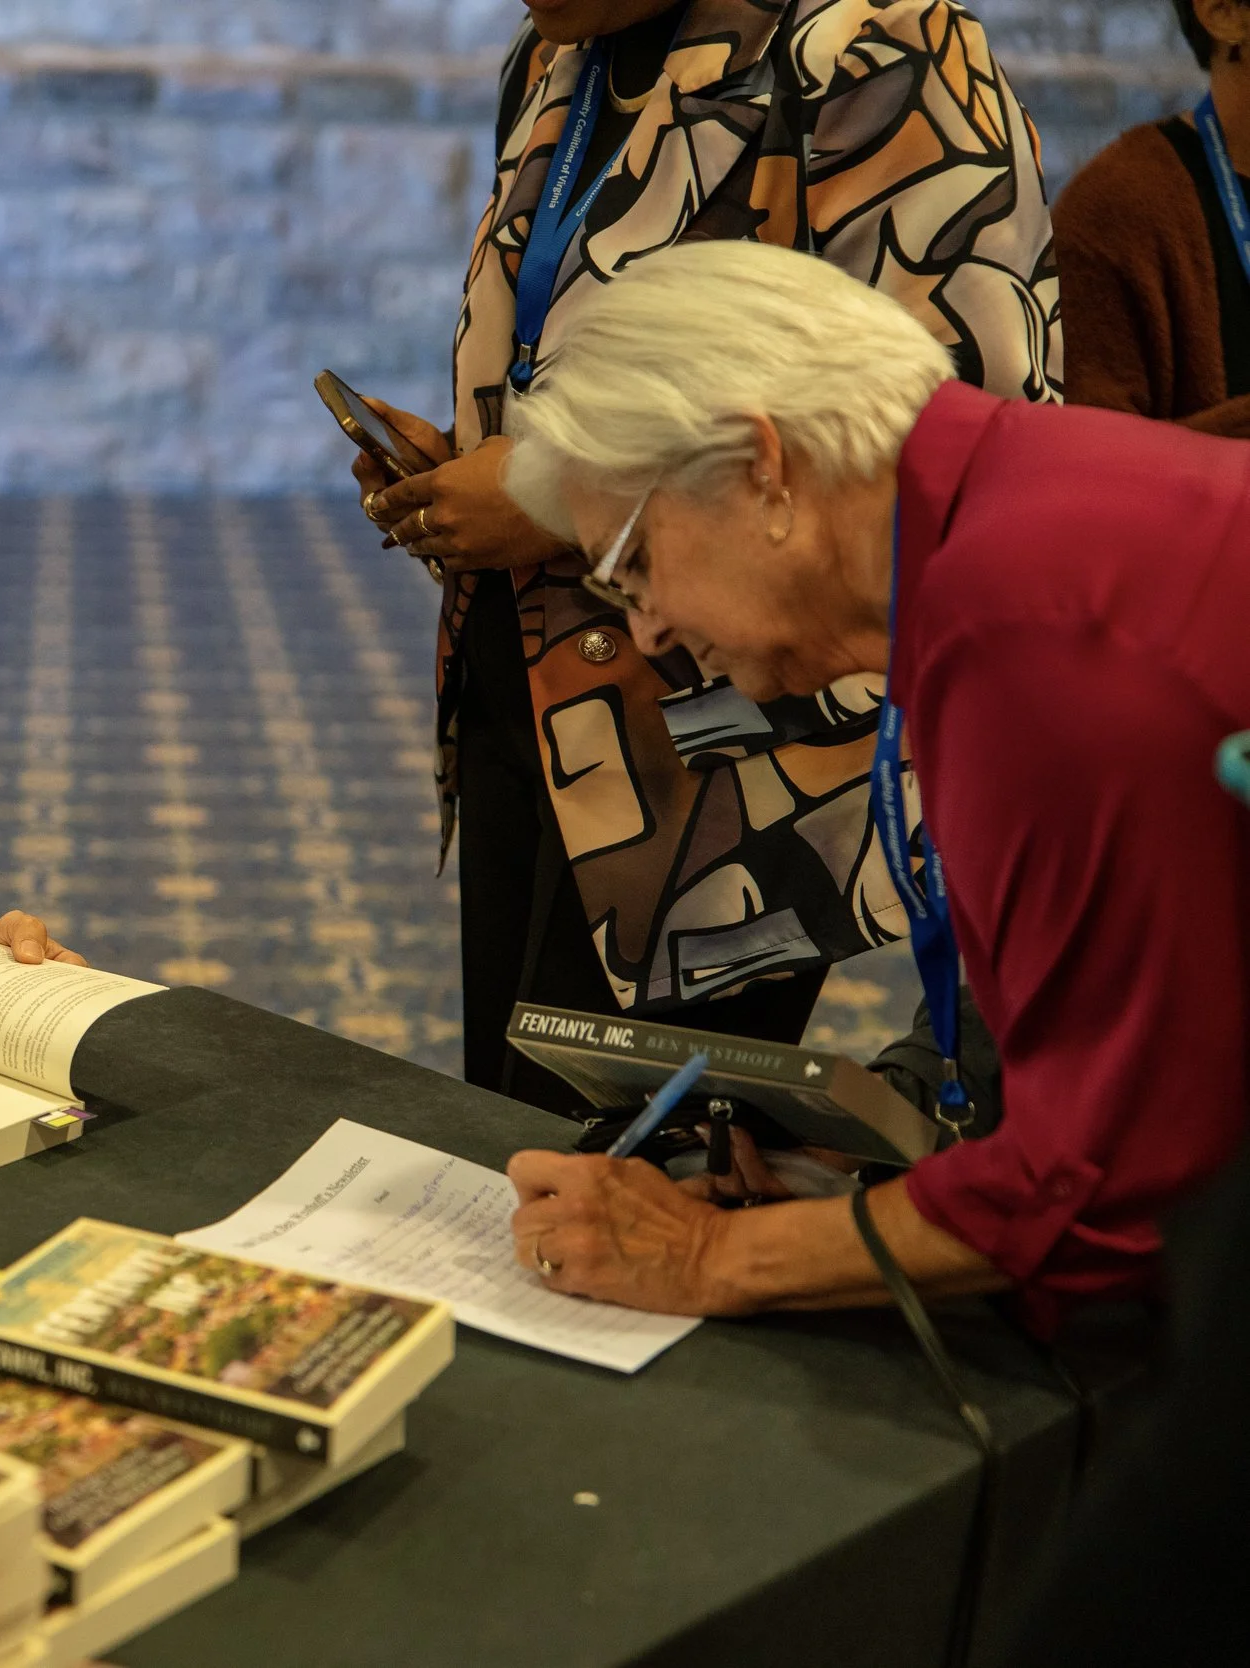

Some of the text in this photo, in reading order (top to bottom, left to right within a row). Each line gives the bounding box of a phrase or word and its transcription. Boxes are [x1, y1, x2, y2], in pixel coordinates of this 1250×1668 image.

[548, 65, 601, 209] Community Coalitions of Virginia
[518, 1011, 599, 1046] FENTANYL,
[602, 1024, 634, 1049] INC.
[645, 1035, 681, 1052] BEN
